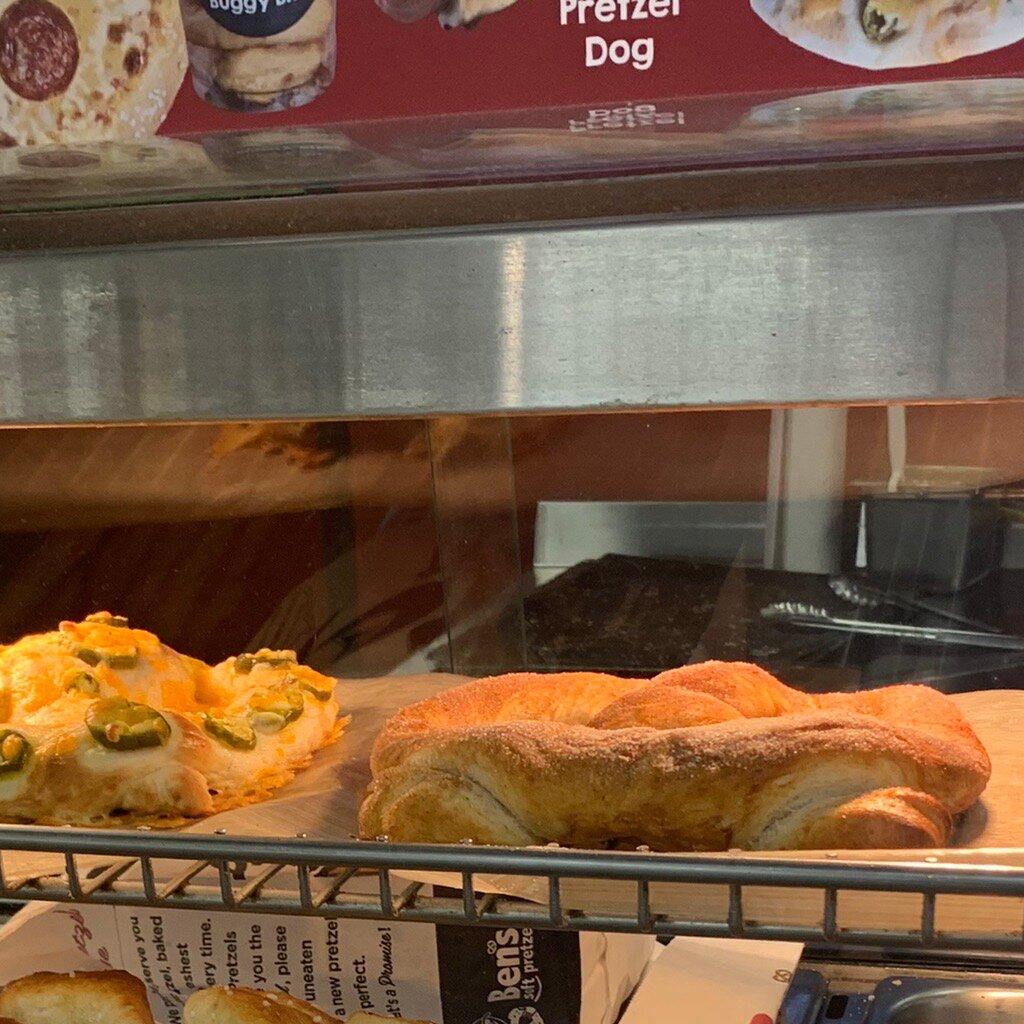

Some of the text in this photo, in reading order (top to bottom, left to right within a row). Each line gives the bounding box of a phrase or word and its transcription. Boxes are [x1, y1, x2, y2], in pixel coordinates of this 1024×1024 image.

[585, 35, 655, 71] Dog
[130, 916, 146, 944] you
[150, 915, 168, 963] baked
[199, 917, 219, 987] ery time.
[248, 924, 267, 984] you the
[275, 925, 291, 977] please
[520, 927, 539, 974] pretze
[177, 942, 195, 990] eshest
[300, 939, 317, 1002] uneaten
[352, 954, 375, 1010] perfect.
[378, 926, 397, 988] Promise!
[329, 976, 343, 1007] new
